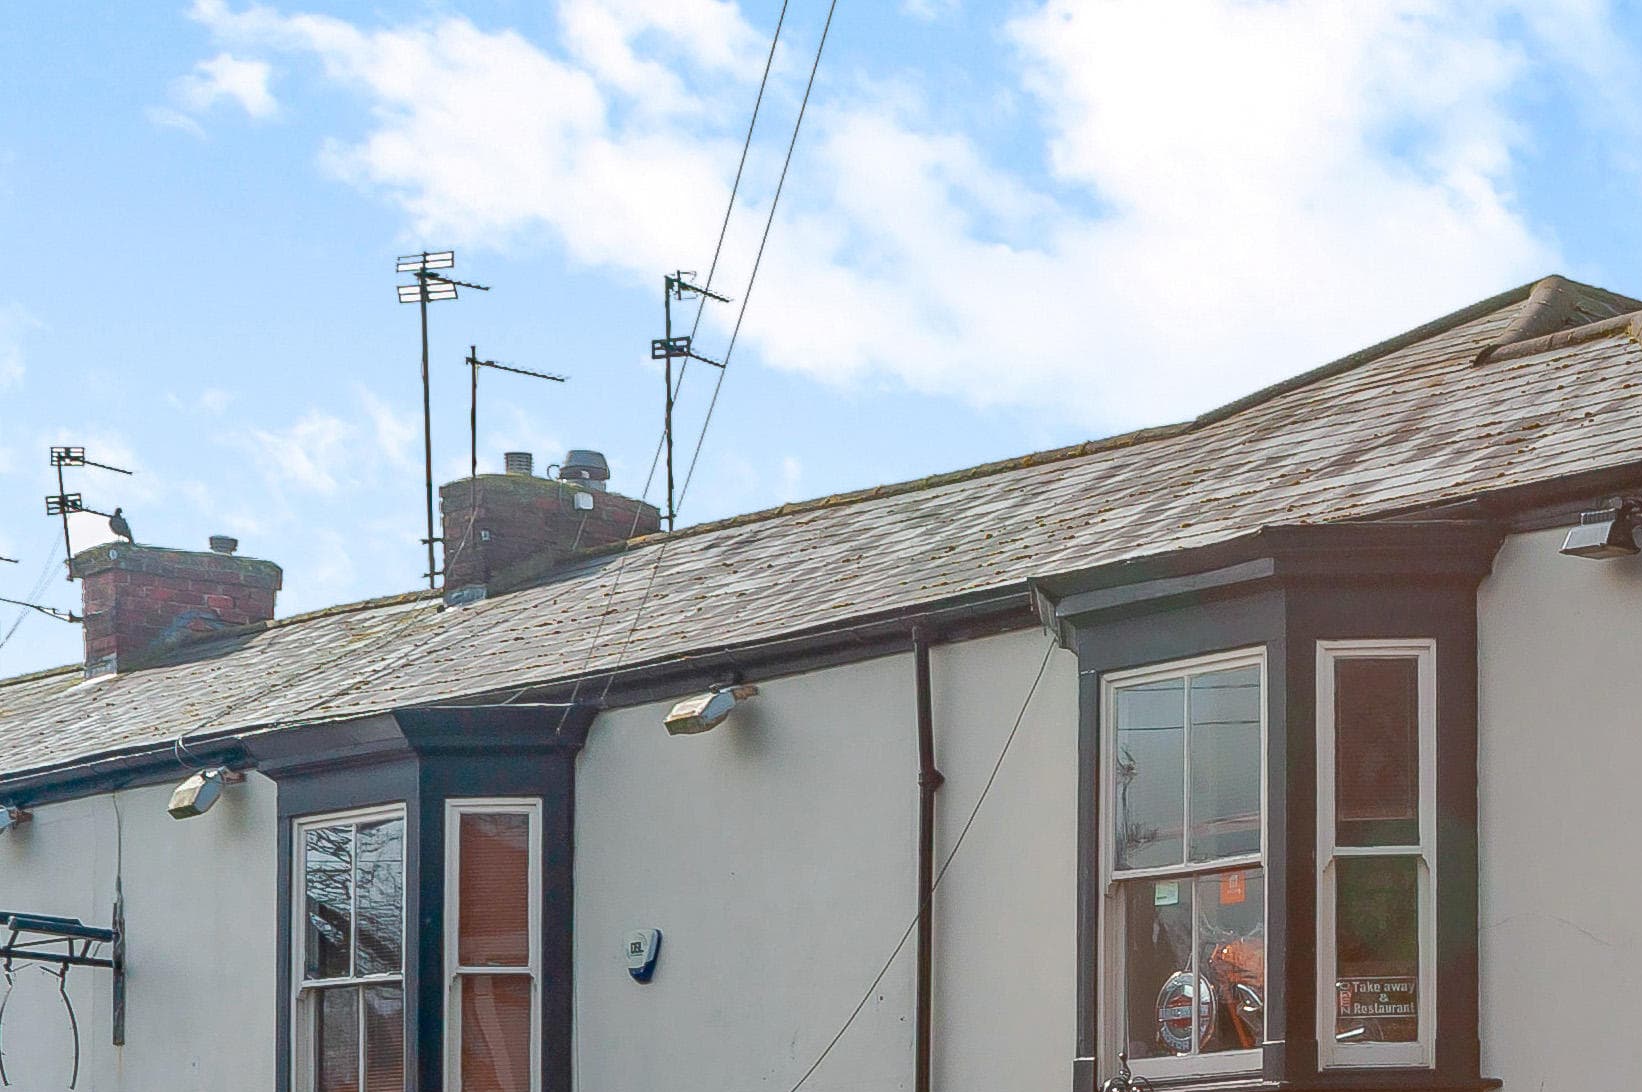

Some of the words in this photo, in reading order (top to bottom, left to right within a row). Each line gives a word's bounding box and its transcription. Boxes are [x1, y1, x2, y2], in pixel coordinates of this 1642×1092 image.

[1352, 981, 1380, 992] Take
[1384, 982, 1415, 994] away
[1379, 993, 1389, 1002] &
[1353, 1002, 1415, 1014] Restaurant
